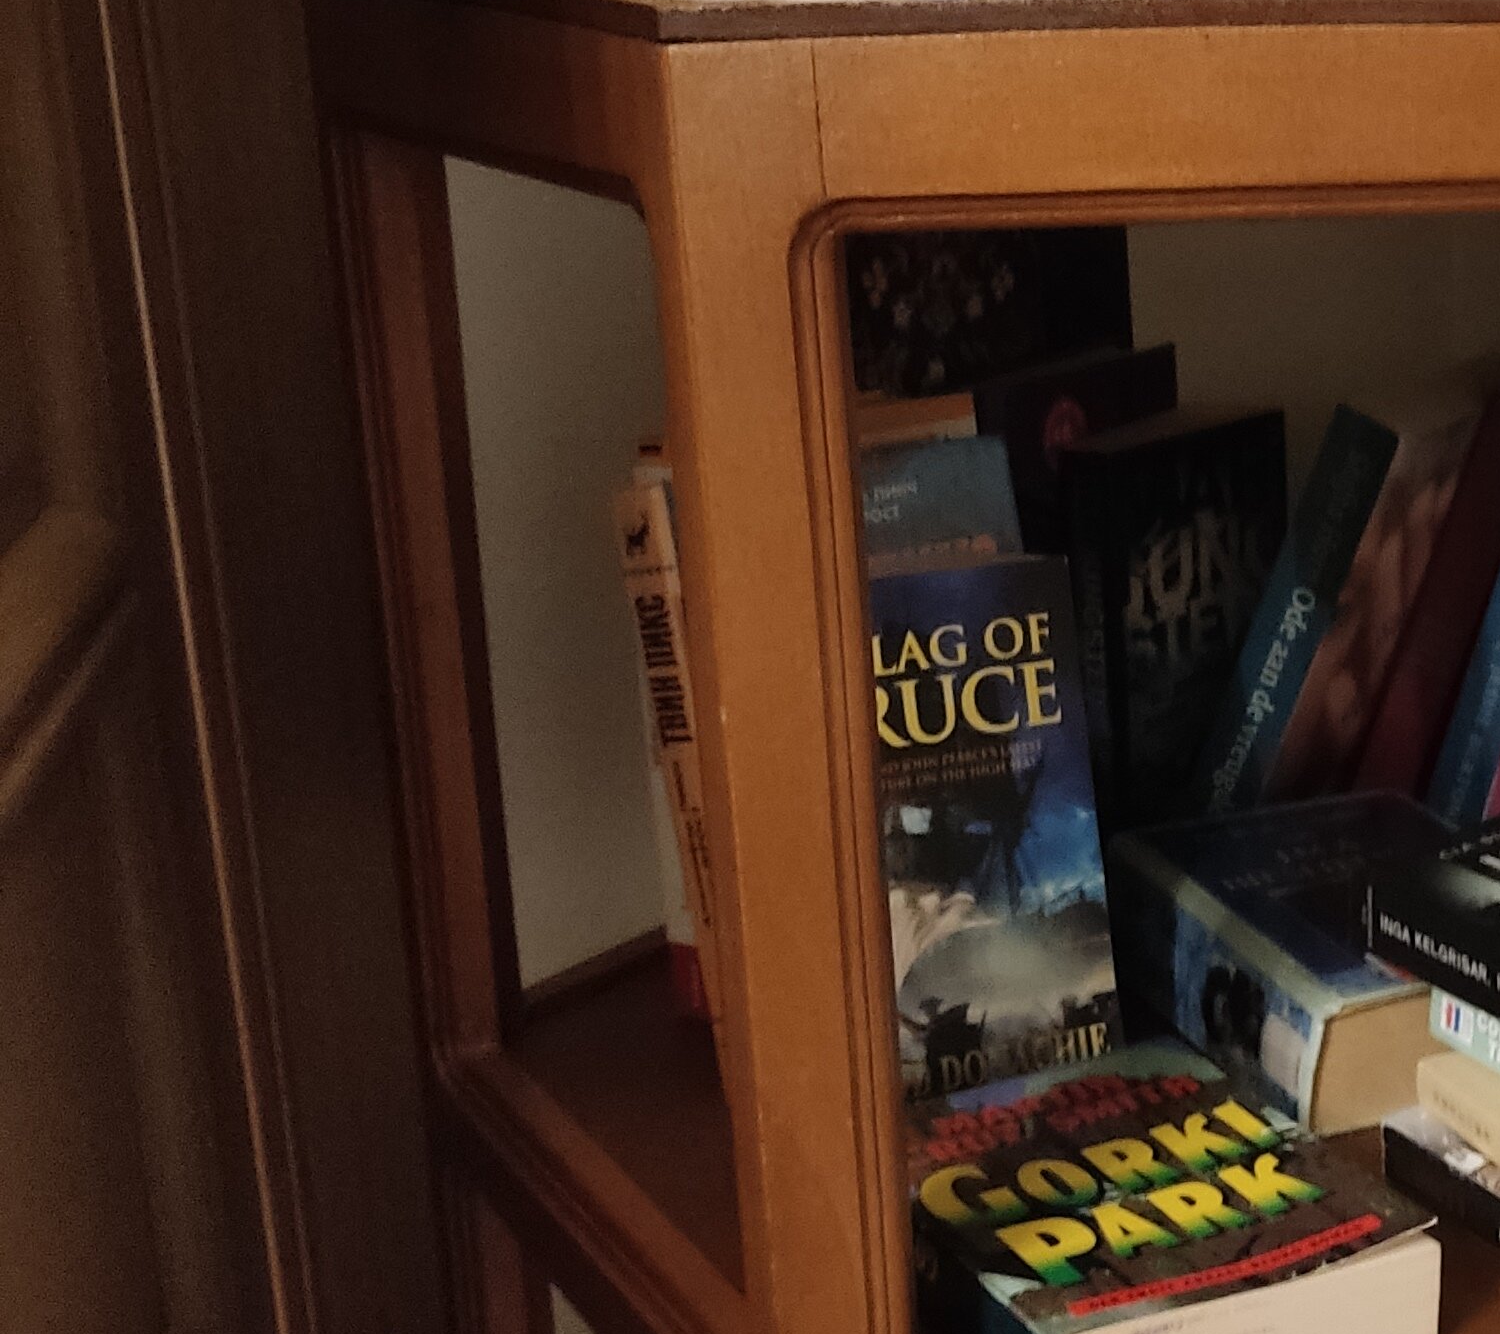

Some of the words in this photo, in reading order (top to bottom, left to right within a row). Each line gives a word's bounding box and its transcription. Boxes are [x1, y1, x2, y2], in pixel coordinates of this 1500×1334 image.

[984, 611, 1052, 660] OF
[1379, 909, 1411, 948] INGA
[920, 1098, 1283, 1225] GORKI
[995, 1153, 1327, 1288] PARK
